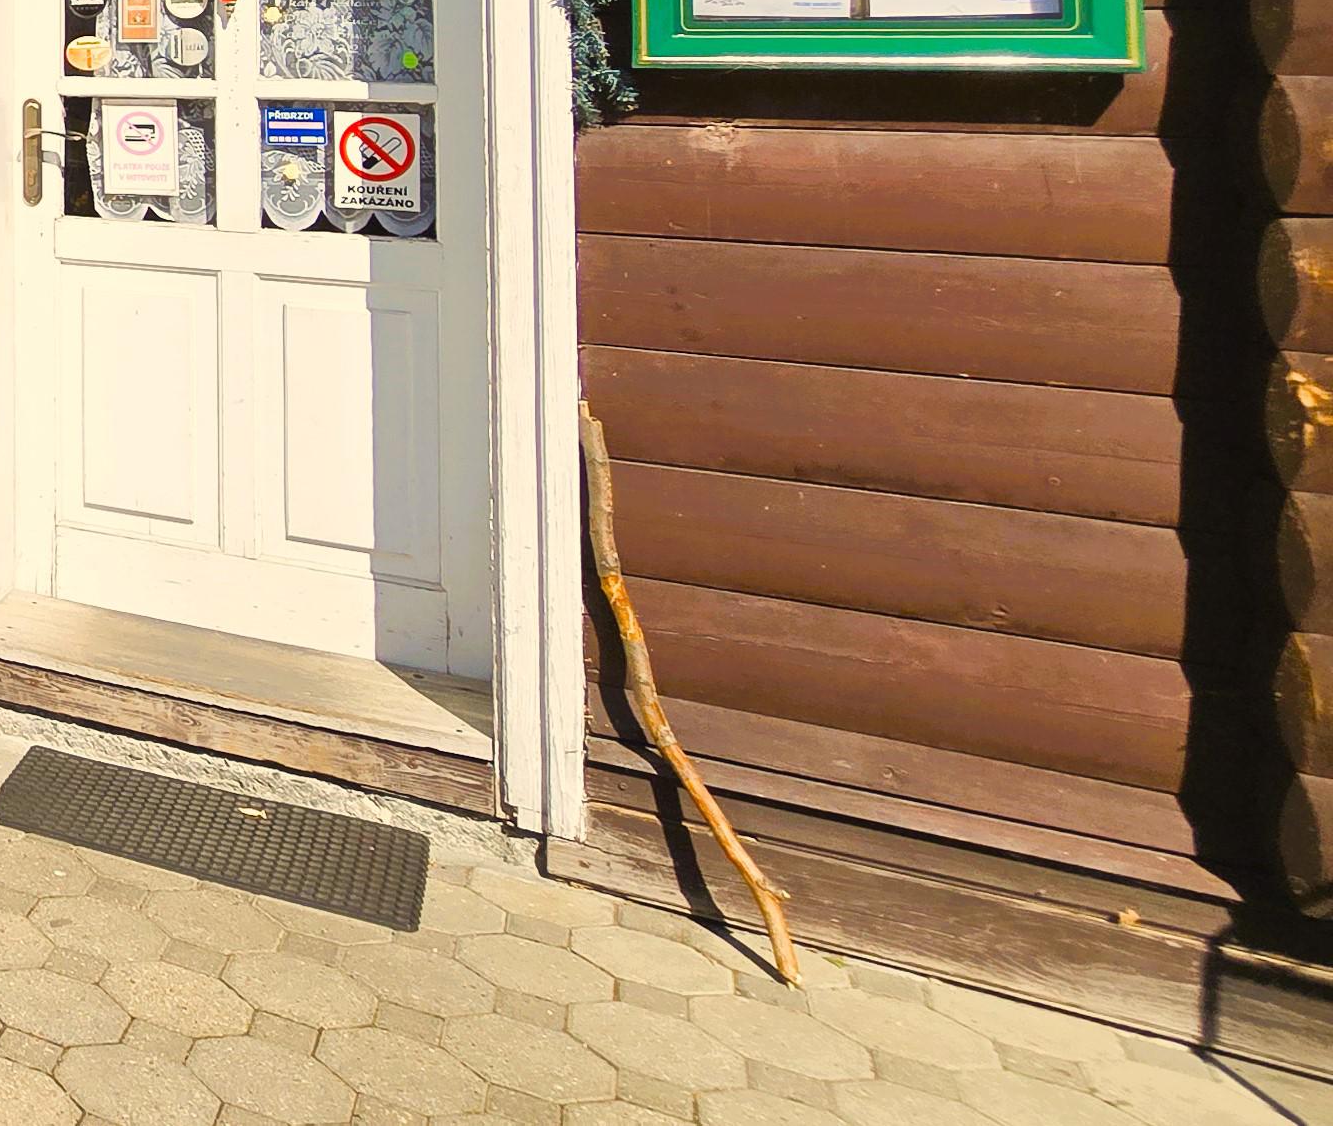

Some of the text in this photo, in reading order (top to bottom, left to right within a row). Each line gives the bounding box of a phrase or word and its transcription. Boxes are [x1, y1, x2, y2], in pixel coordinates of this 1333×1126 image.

[268, 109, 314, 121] PŘIBRZDI
[347, 184, 408, 197] KOUŘENÍ
[340, 196, 415, 209] ZAKÁZÁNO
